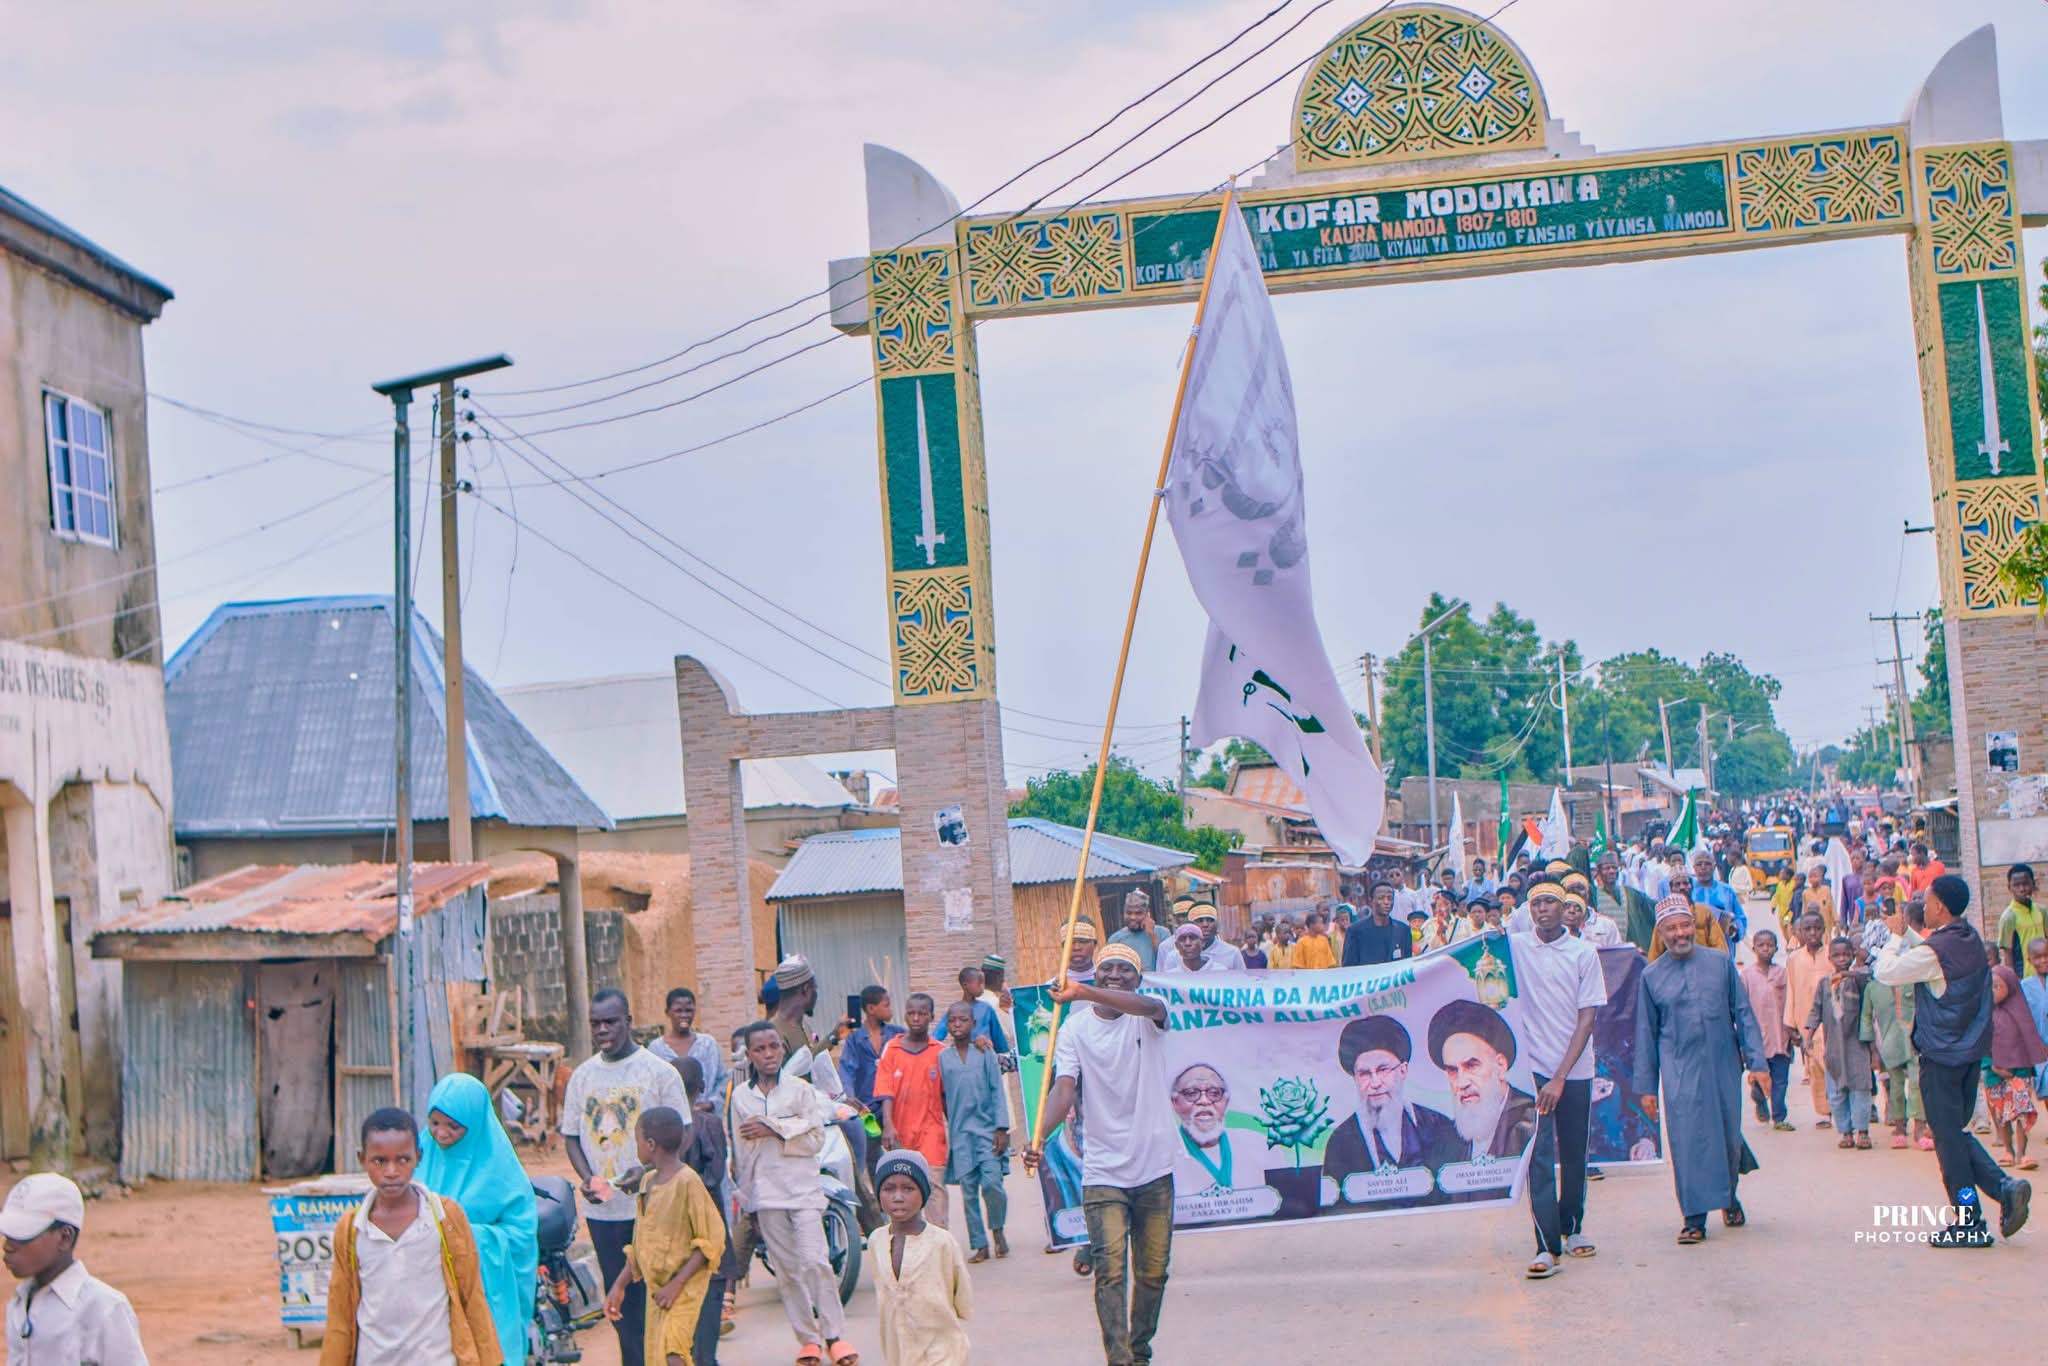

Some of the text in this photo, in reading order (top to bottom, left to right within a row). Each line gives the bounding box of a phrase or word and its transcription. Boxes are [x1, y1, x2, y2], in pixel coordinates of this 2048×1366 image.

[1257, 175, 1600, 233] KOFAR MODOMAWA
[1136, 263, 1185, 284] KOFAR
[1292, 249, 1309, 267] YA
[1313, 246, 1343, 265] FITA
[1432, 235, 1449, 253] YA
[1455, 231, 1507, 252] DAUKO
[1515, 224, 1576, 245] FANSAR
[1664, 209, 1725, 232] NAMODA
[1320, 208, 1538, 247] KAURA NAMODA 1807-1810
[1190, 987, 1265, 1007] MURNA
[1273, 987, 1307, 1006] DA
[1311, 968, 1416, 1004] MAULUDIN
[1170, 1007, 1264, 1031] ANZON
[1274, 1003, 1362, 1024] ALLAH
[278, 1235, 333, 1262] POS
